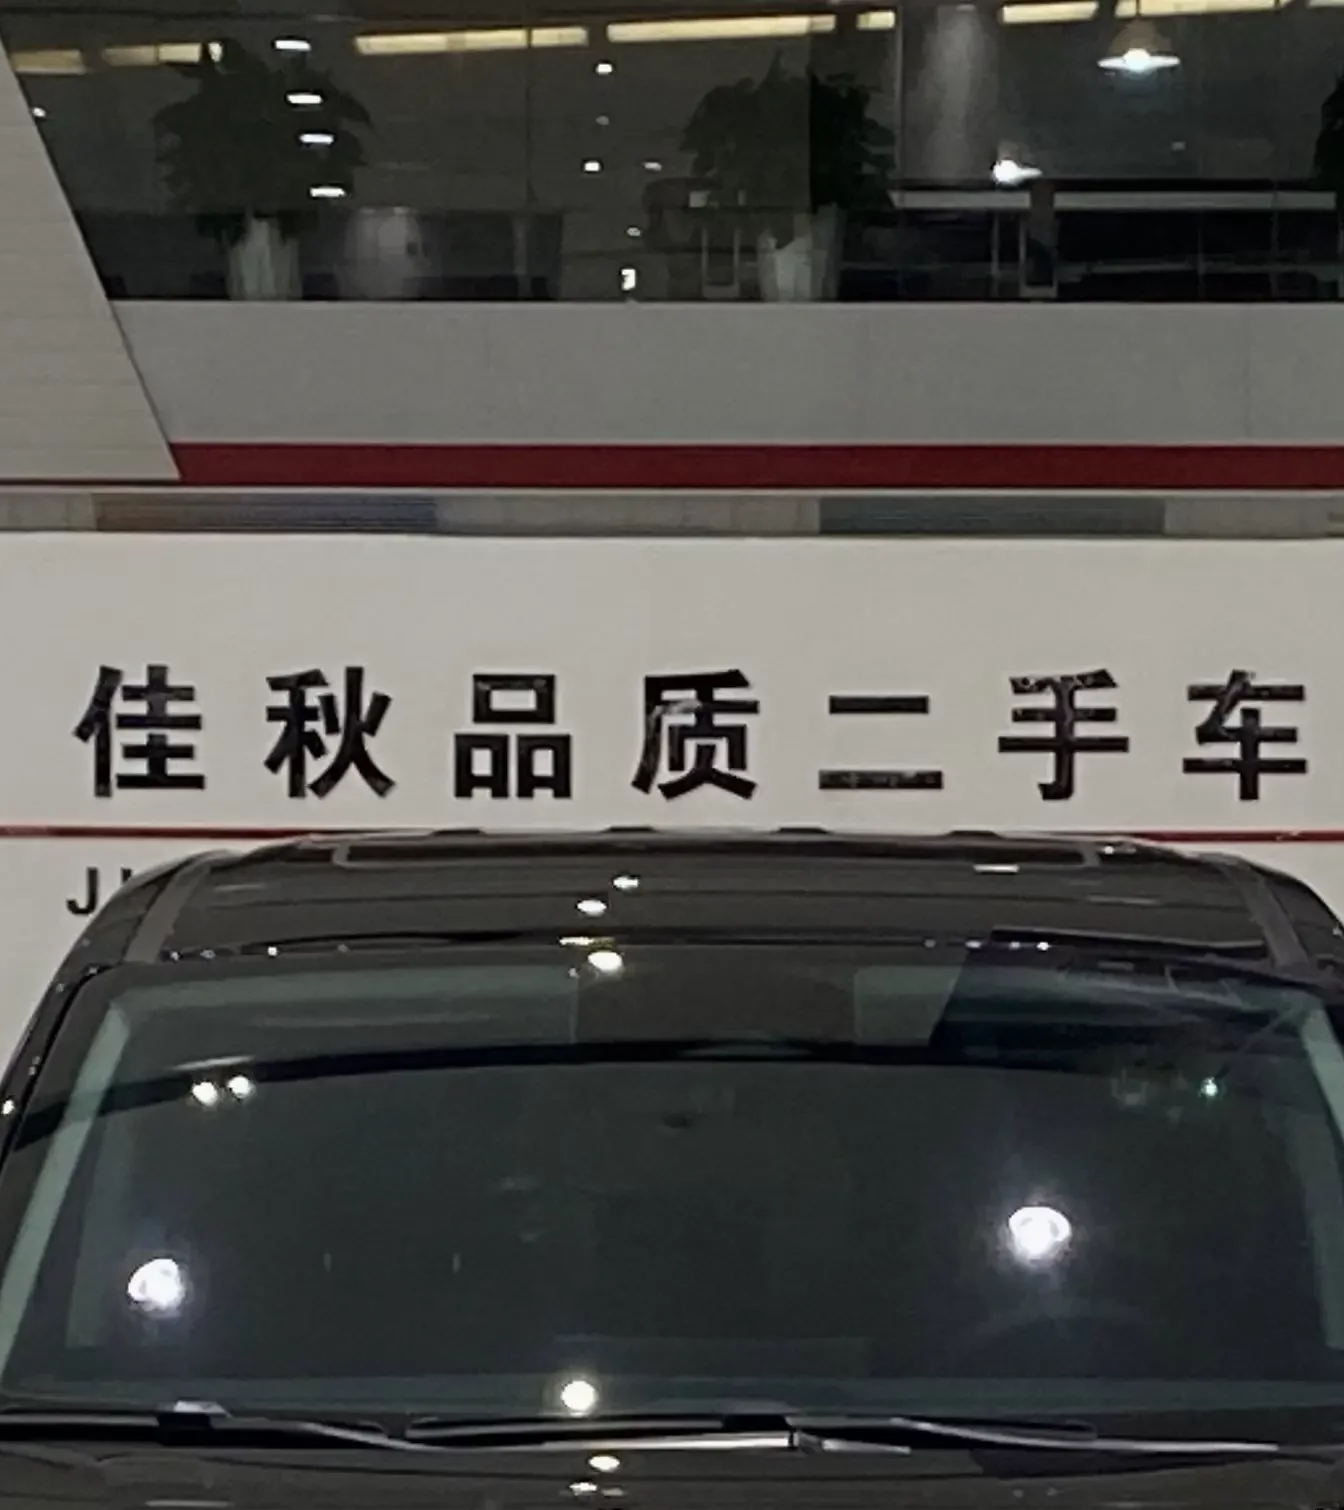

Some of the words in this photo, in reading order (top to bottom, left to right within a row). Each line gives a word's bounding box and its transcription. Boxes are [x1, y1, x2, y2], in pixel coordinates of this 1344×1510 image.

[71, 664, 1310, 802] 佳秋品质二手车
